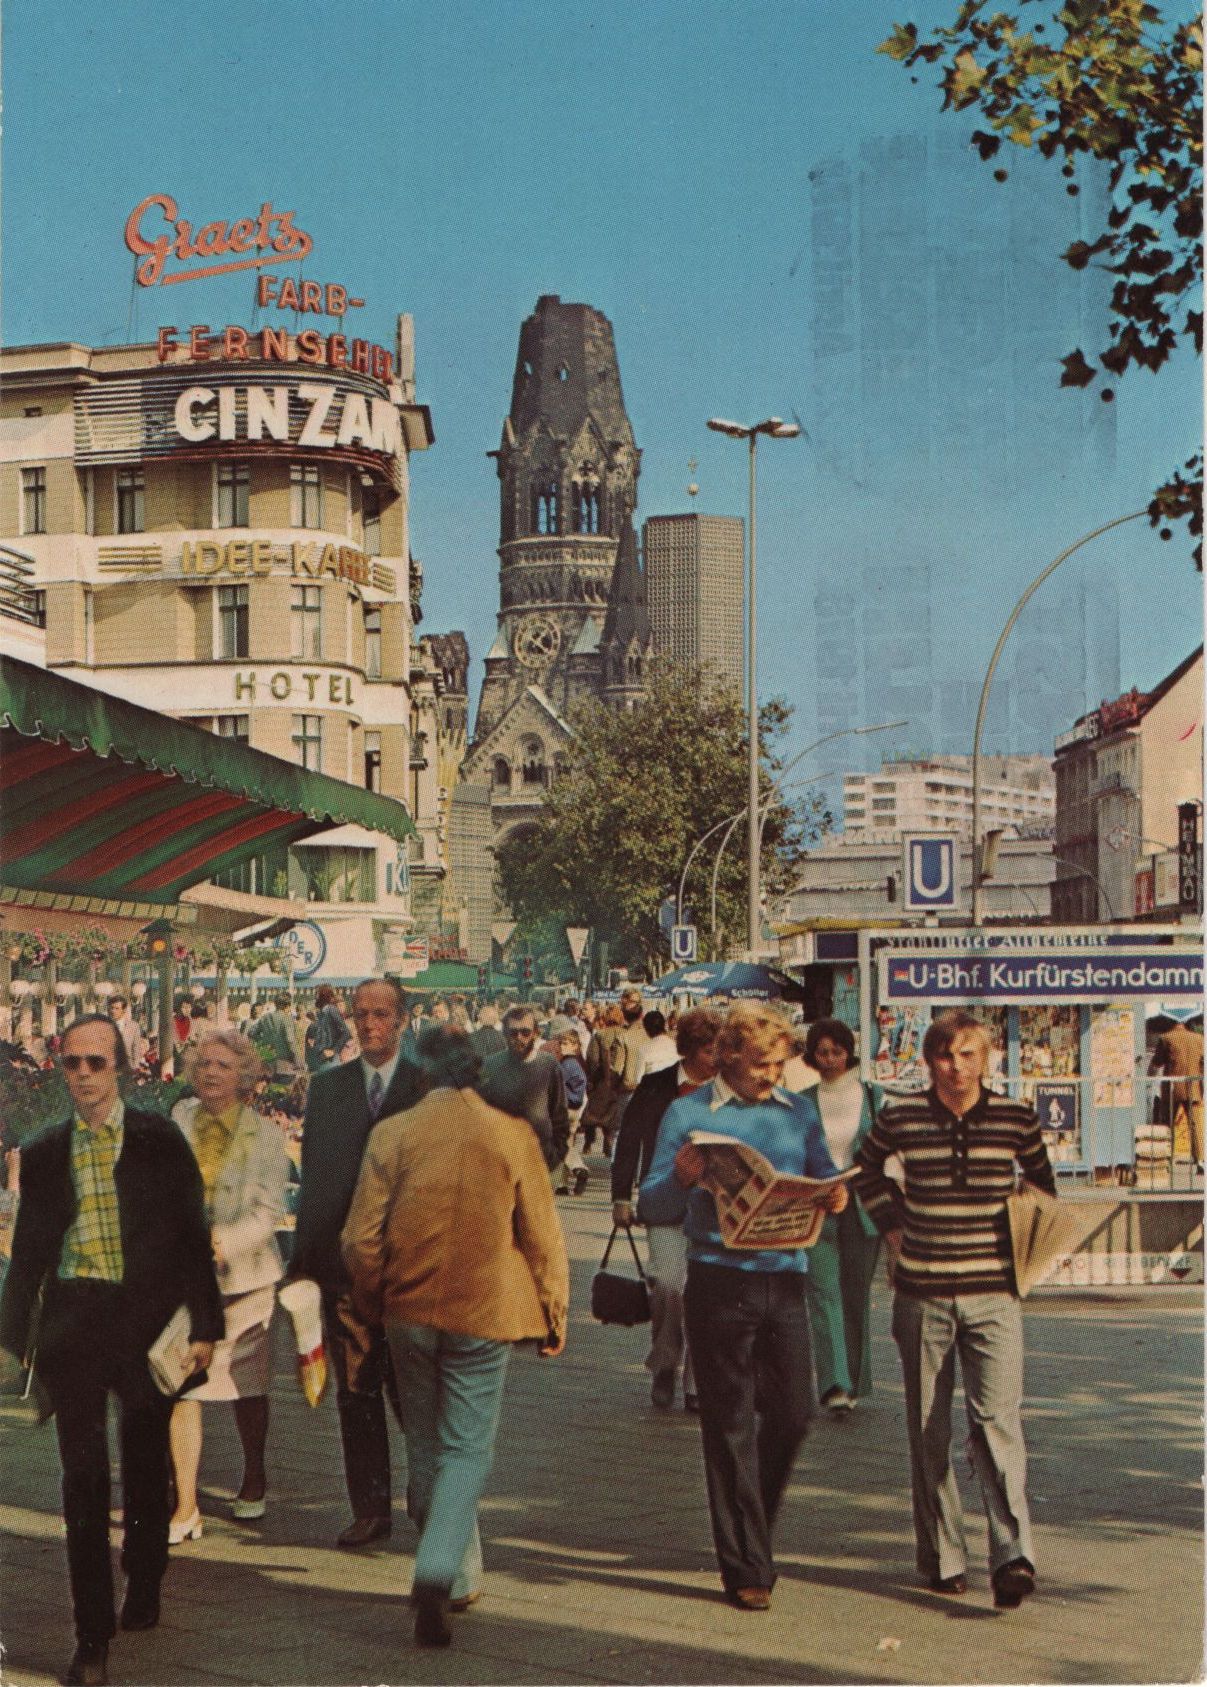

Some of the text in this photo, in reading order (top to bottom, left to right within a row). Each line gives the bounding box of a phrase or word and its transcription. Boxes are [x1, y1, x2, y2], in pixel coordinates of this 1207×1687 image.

[124, 193, 313, 287] Graetz
[258, 275, 365, 317] FARB-
[235, 671, 354, 706] HOTEL
[913, 844, 951, 899] U
[675, 931, 692, 957] U
[908, 962, 983, 989] U-Bhf.
